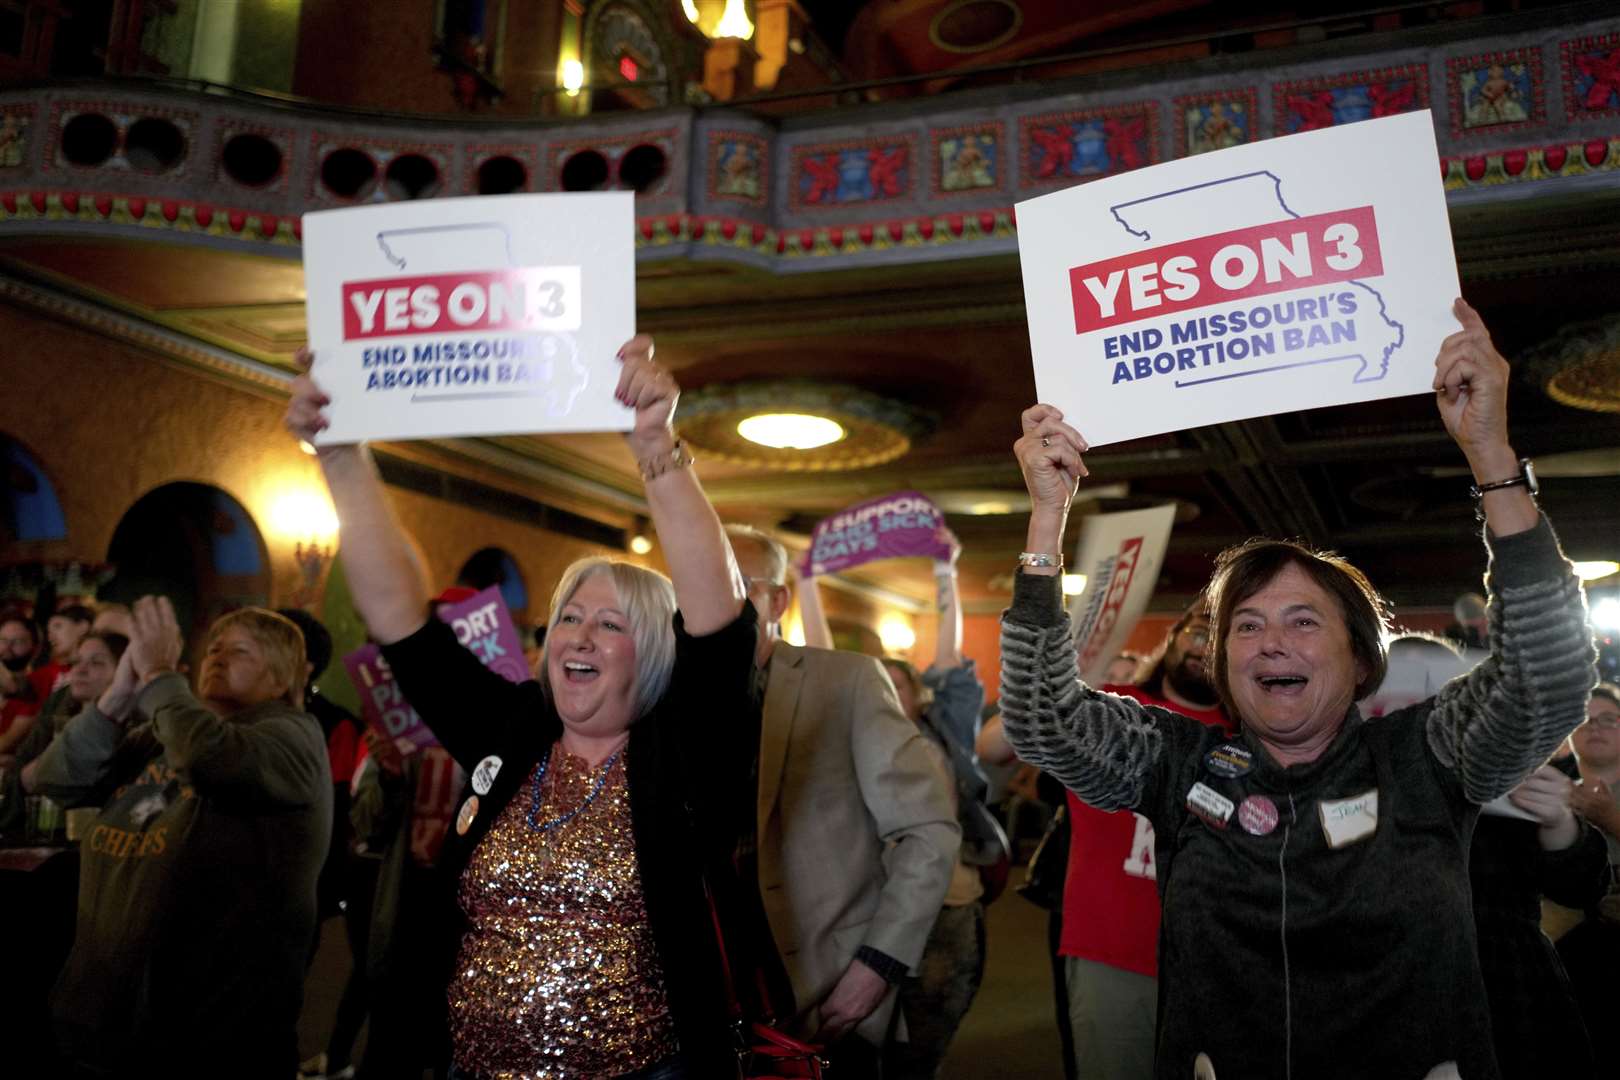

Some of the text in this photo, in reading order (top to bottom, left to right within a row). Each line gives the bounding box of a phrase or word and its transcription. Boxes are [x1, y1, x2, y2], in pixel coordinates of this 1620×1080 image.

[1082, 223, 1364, 319] YES ON 3
[351, 279, 566, 335] YES ON 3
[1103, 291, 1359, 360] END MISSOURI'S
[361, 345, 406, 369] END
[365, 361, 552, 392] ABORTION BA
[1111, 319, 1357, 385] ABORTION BAN
[812, 534, 878, 562] DAYS
[1108, 544, 1139, 606] YES
